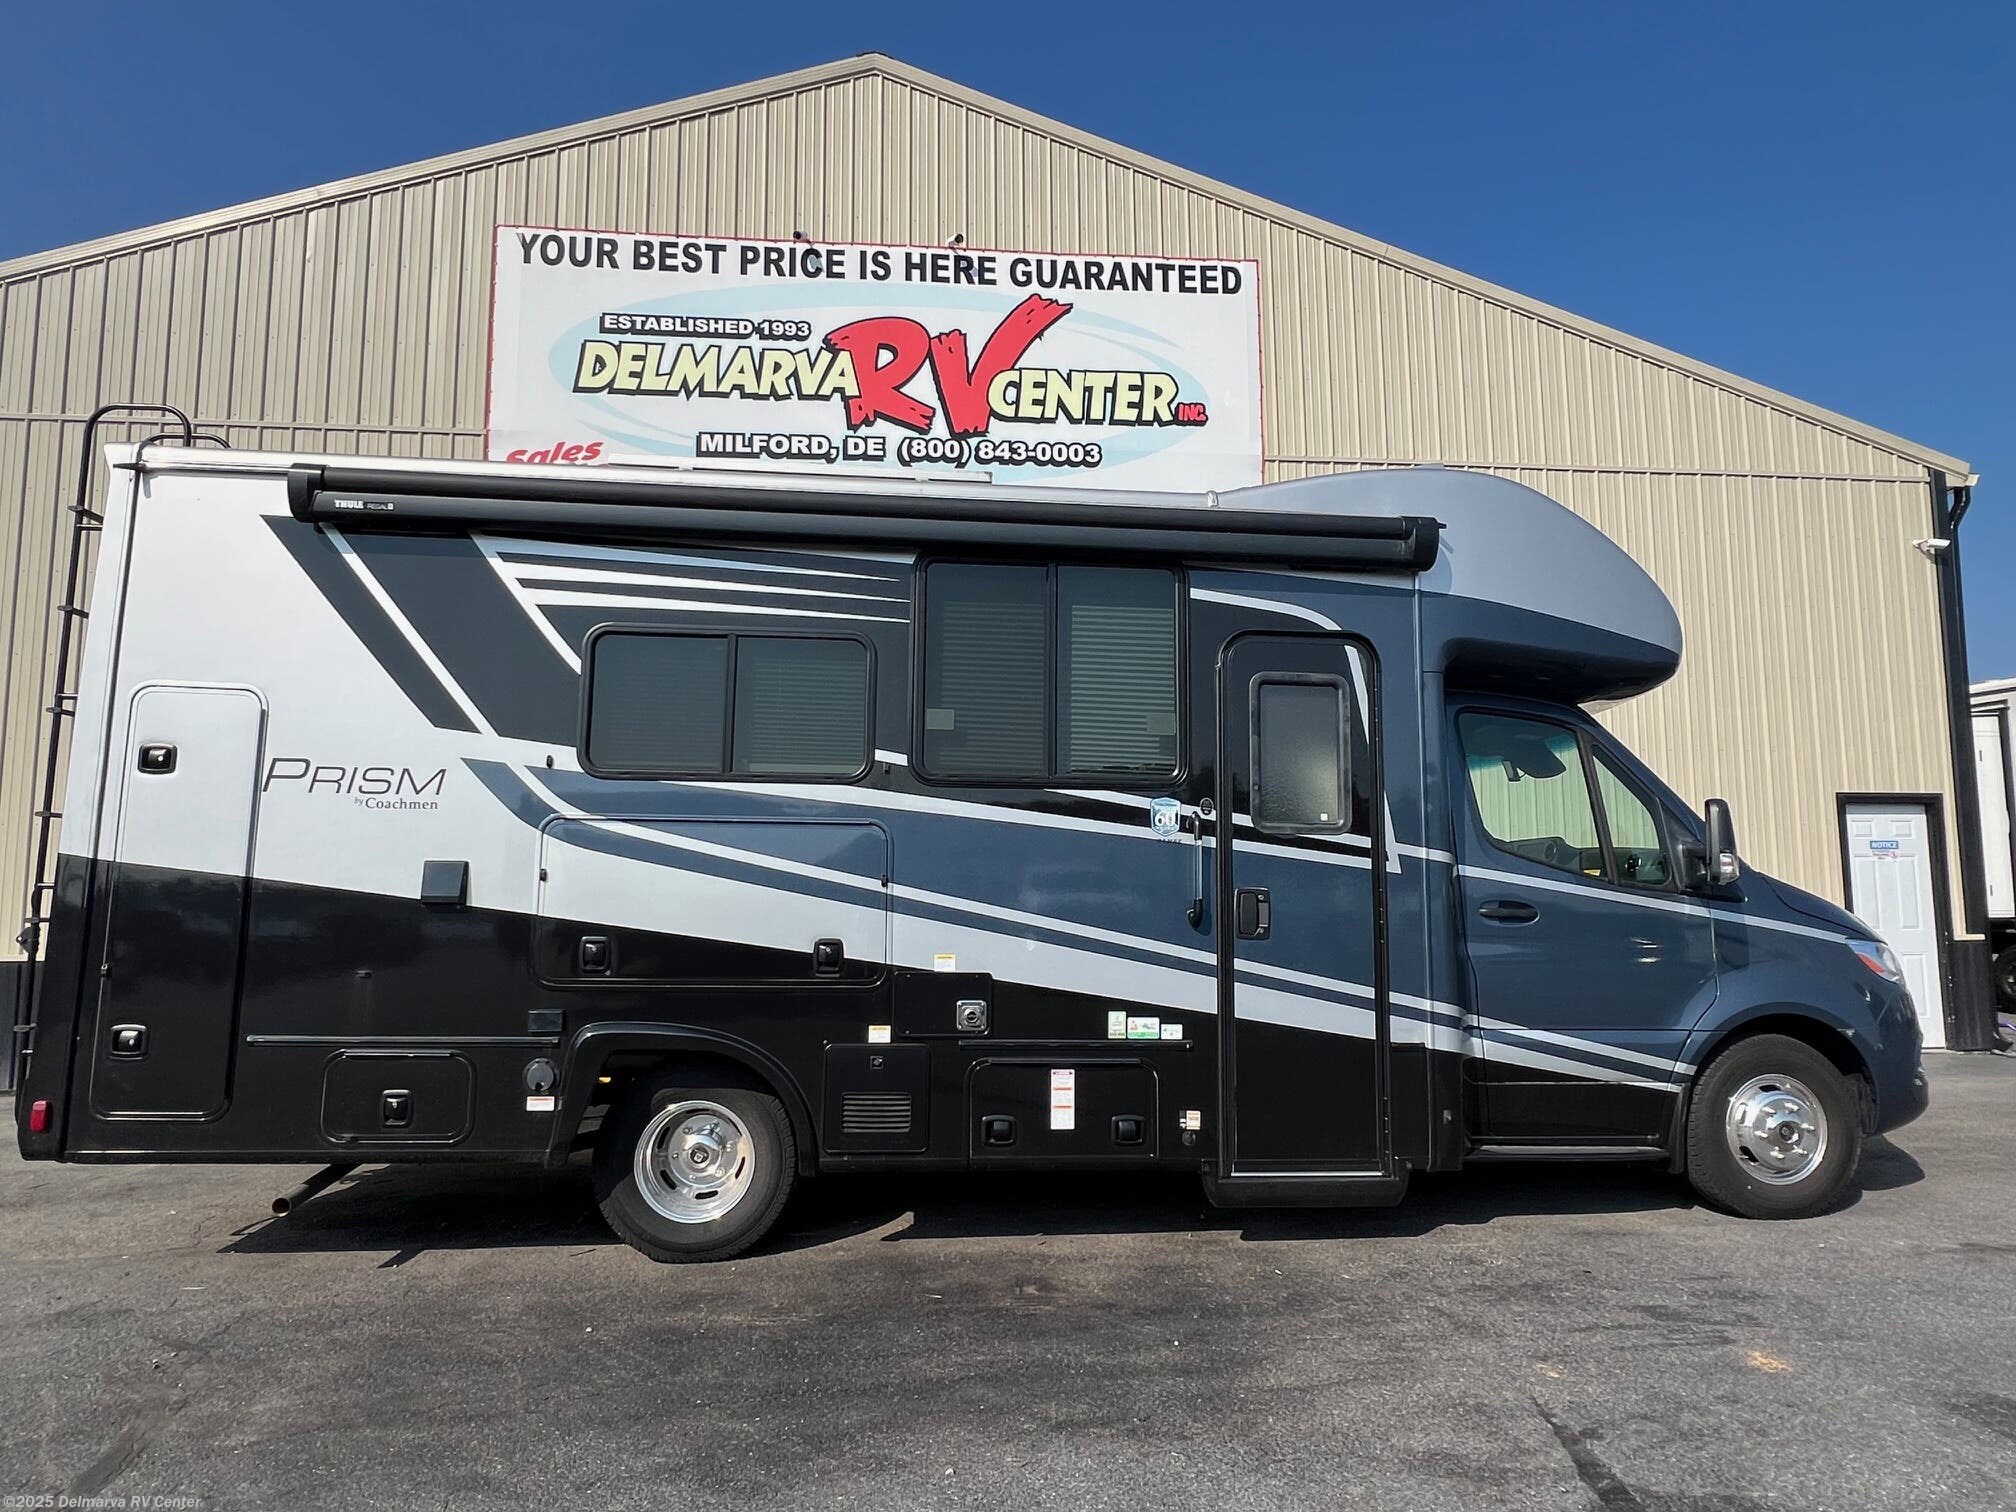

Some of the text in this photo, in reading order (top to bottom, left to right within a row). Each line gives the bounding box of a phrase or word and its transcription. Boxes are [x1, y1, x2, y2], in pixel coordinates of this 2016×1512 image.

[516, 232, 1242, 295] YOUR BEST PRICE IS HERE GUARANTEED
[601, 313, 811, 338] ESTABLISHED 1993
[574, 340, 861, 399] DELMARVA
[823, 294, 1073, 437] RV
[988, 368, 1179, 426] CENTER
[698, 433, 1102, 467] MILFORD, DE (800) 843-0003
[334, 499, 364, 509] THULE
[354, 797, 438, 810] by Coachmen
[1871, 841, 1898, 849] NOTICE
